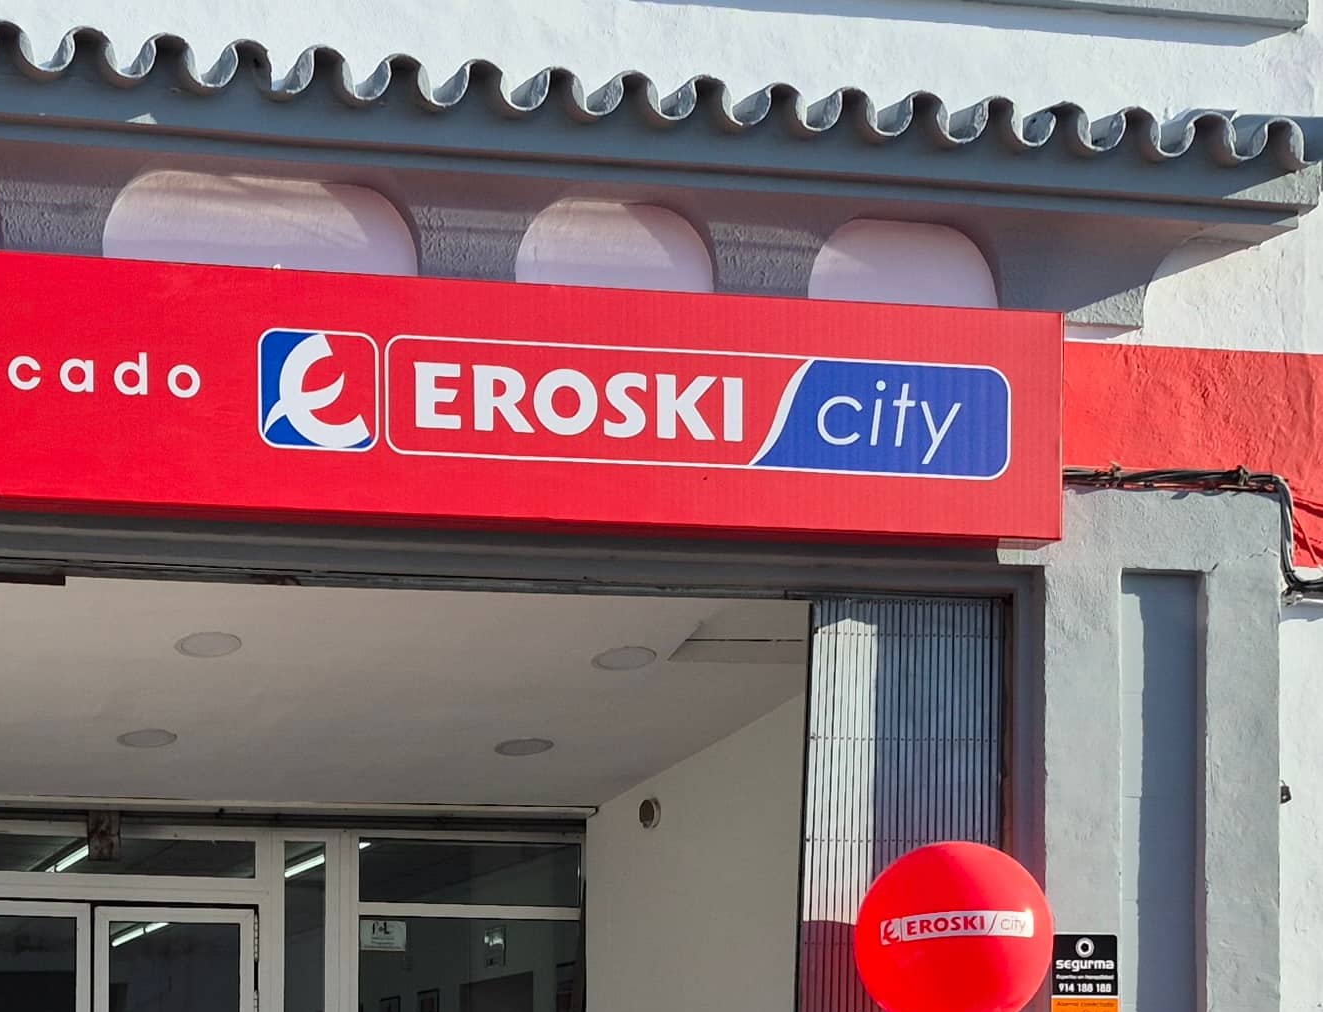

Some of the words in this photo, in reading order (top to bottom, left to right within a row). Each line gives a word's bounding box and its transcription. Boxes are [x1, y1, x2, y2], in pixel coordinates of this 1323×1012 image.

[413, 360, 744, 442] EROSKI
[815, 379, 963, 465] city
[906, 915, 986, 936] EROSKI
[1000, 917, 1027, 932] city
[1055, 959, 1115, 973] segurma
[1058, 983, 1075, 993] 914
[1076, 983, 1094, 993] 188
